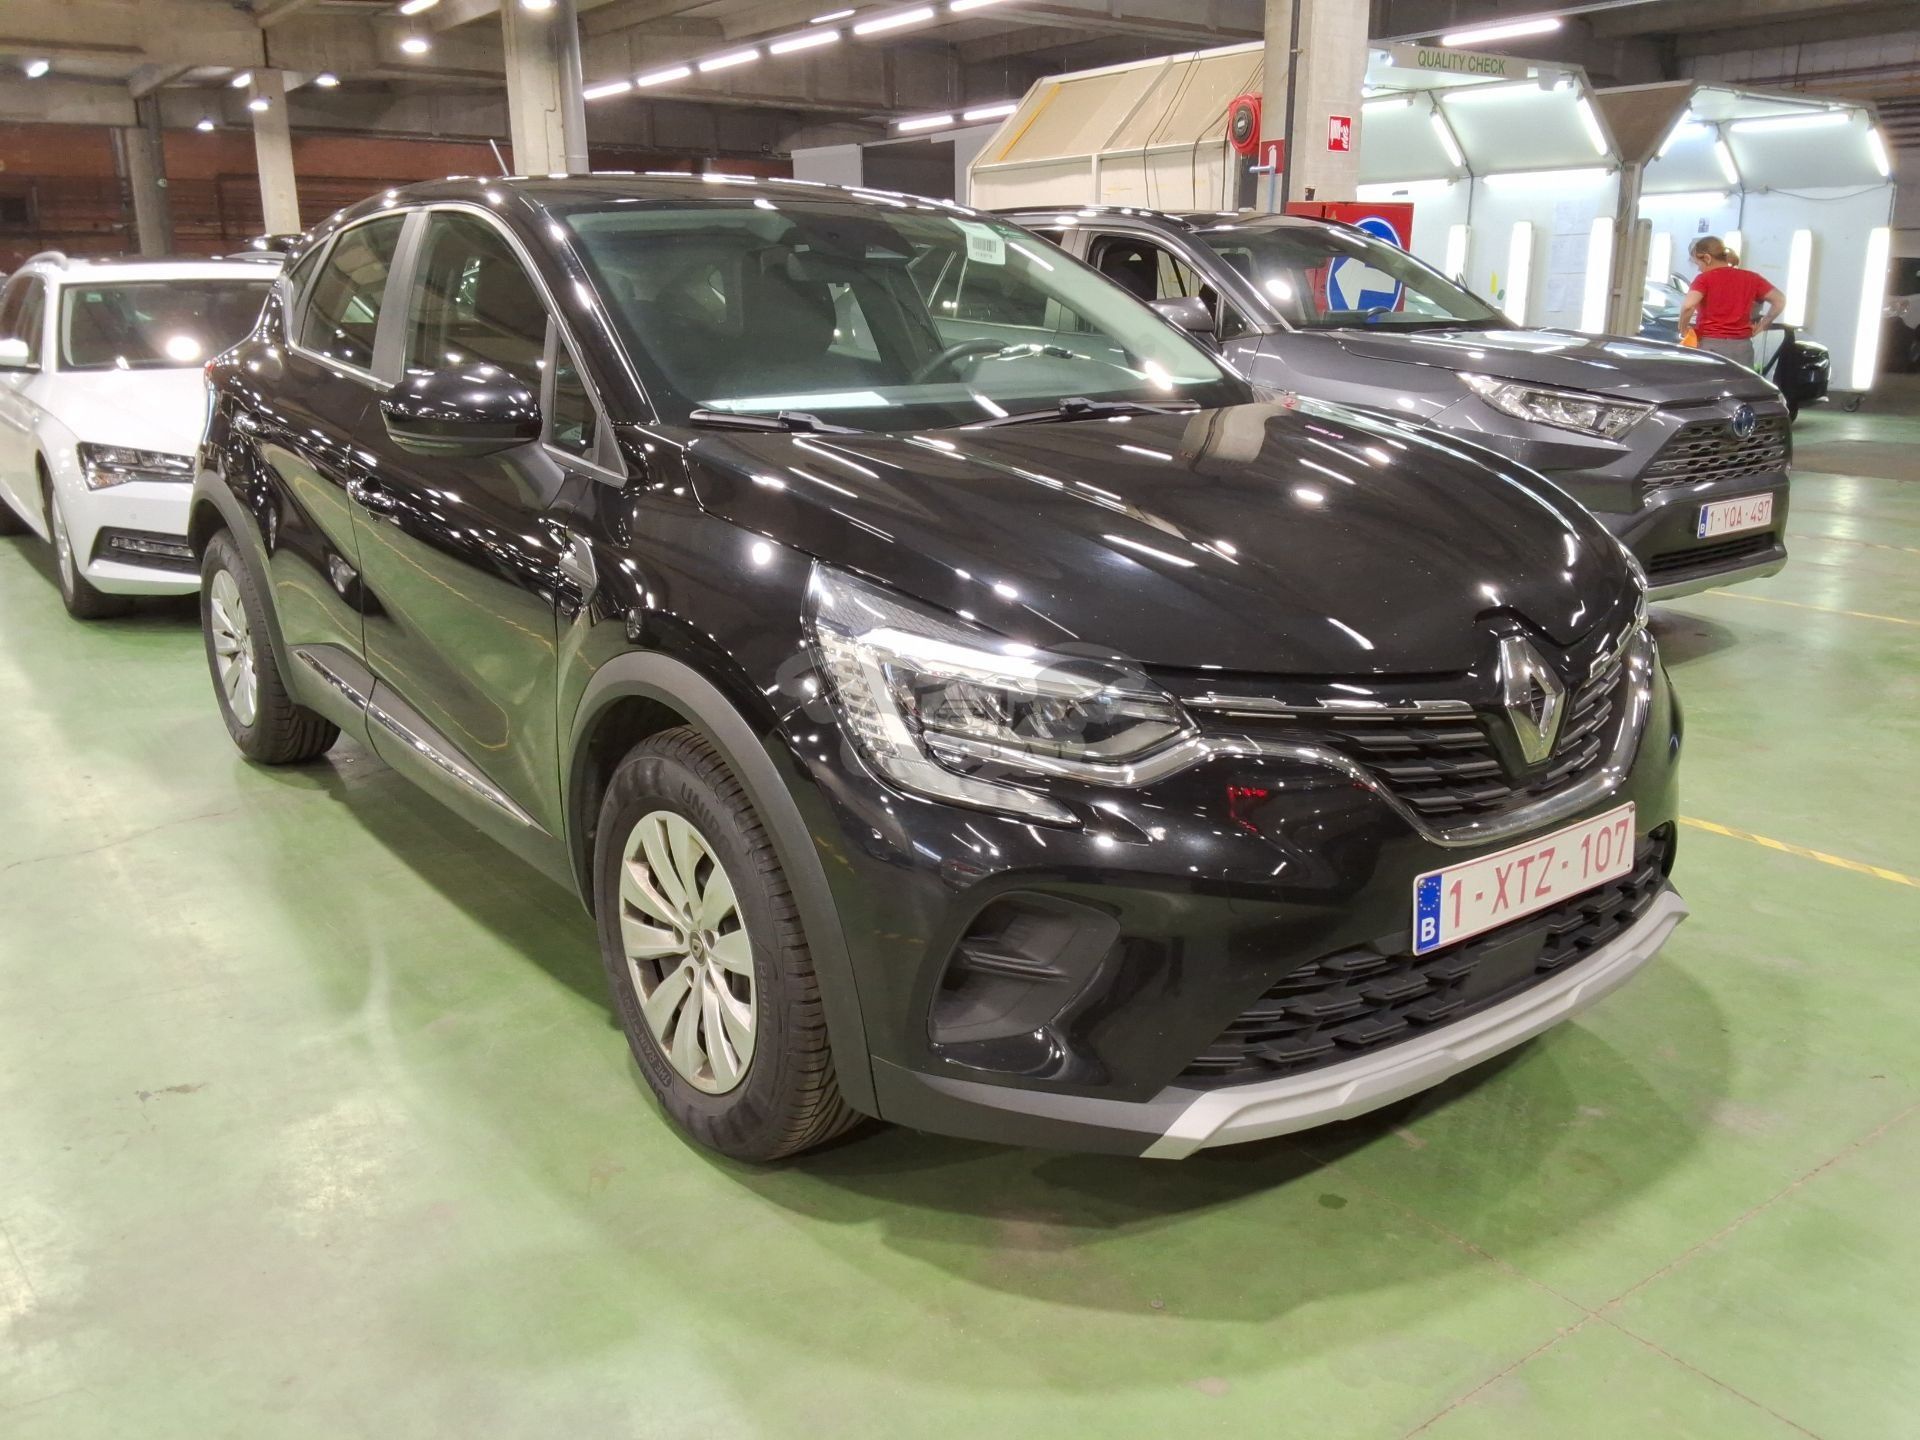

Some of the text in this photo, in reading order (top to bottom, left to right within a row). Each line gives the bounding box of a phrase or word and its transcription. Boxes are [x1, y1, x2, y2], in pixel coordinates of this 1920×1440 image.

[1418, 50, 1506, 75] QUALITY CHECK
[1700, 523, 1706, 534] B
[1449, 818, 1630, 929] 1-XTZ-107
[1421, 917, 1436, 943] B
[638, 1033, 657, 1062] RAIN
[654, 1063, 673, 1086] THE
